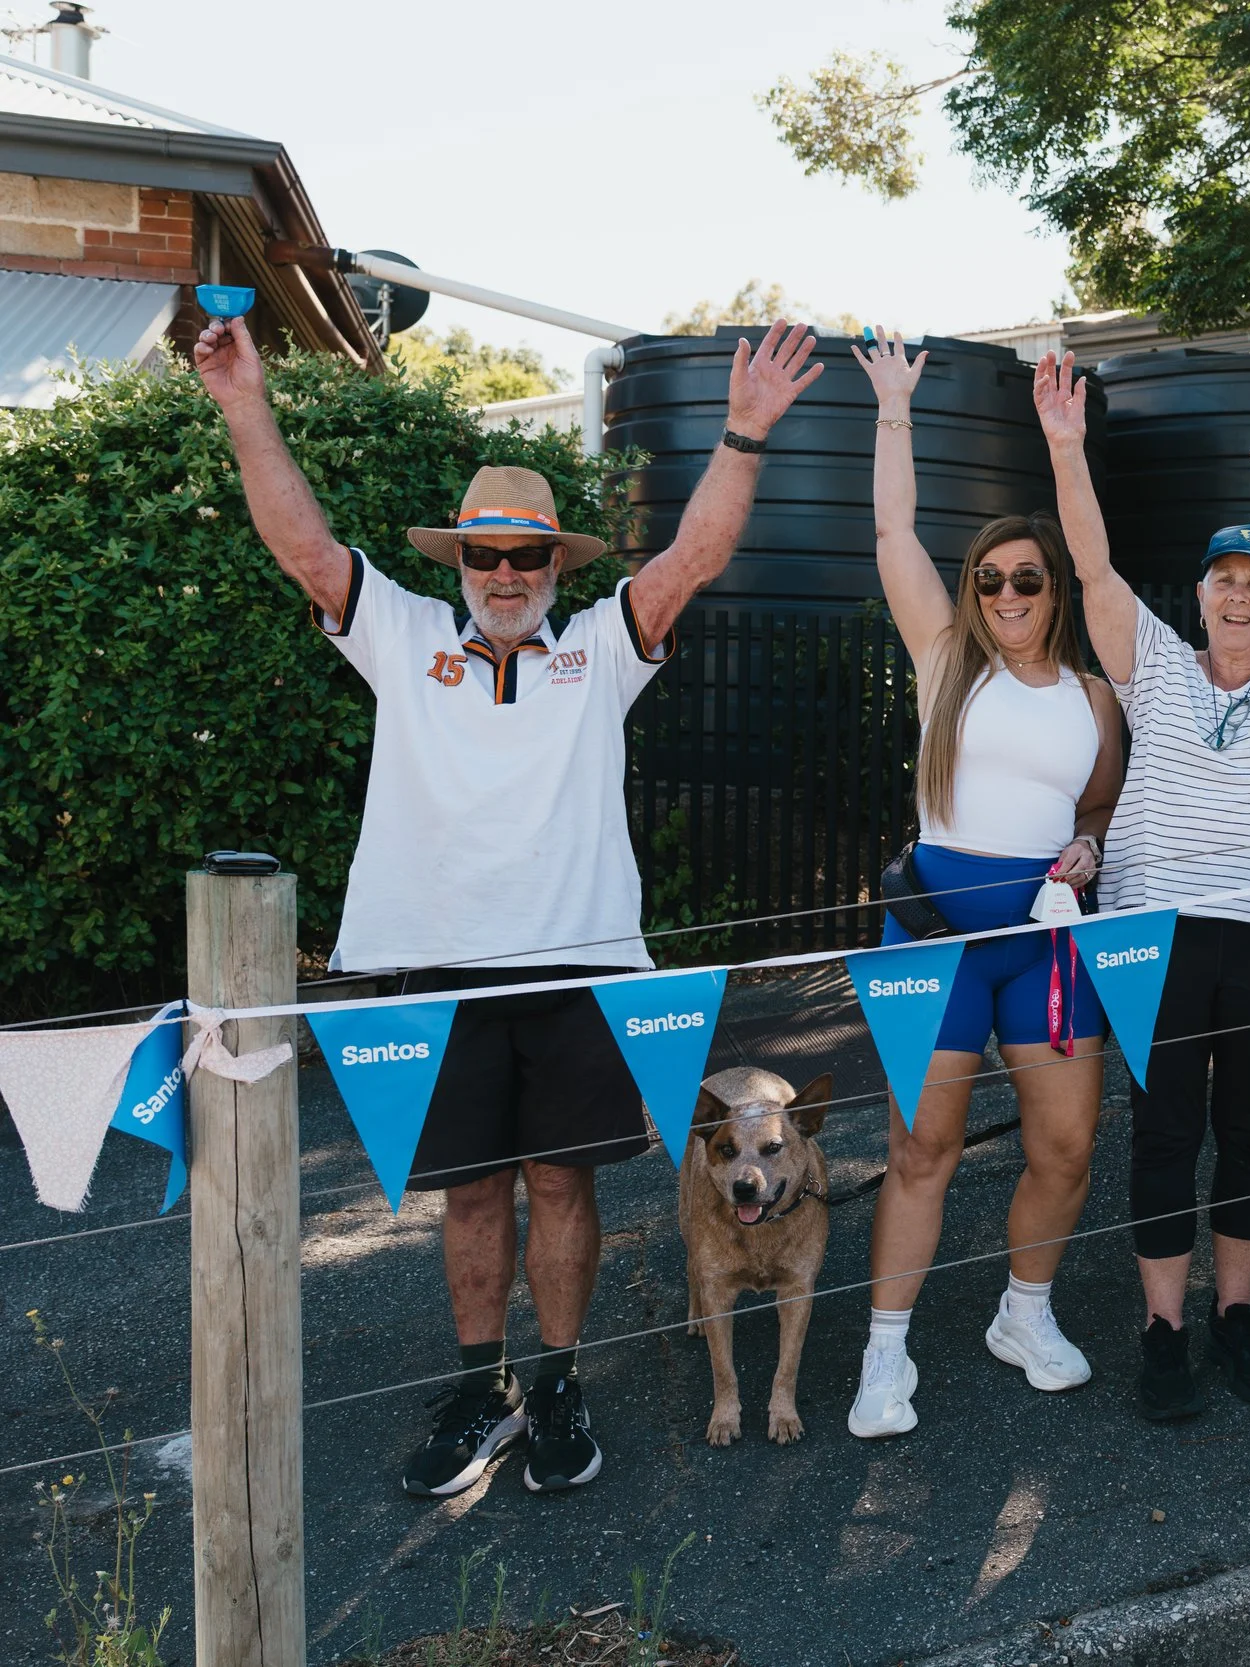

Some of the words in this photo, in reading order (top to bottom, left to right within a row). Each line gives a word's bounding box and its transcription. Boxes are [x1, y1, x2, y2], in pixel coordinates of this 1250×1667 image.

[427, 651, 468, 686] 15
[545, 649, 587, 673] TDU
[551, 676, 583, 685] ADELAIDE
[1096, 945, 1160, 970] Santos
[868, 977, 940, 998] Santos
[625, 1011, 705, 1037] Santos
[341, 1041, 430, 1066] Santos
